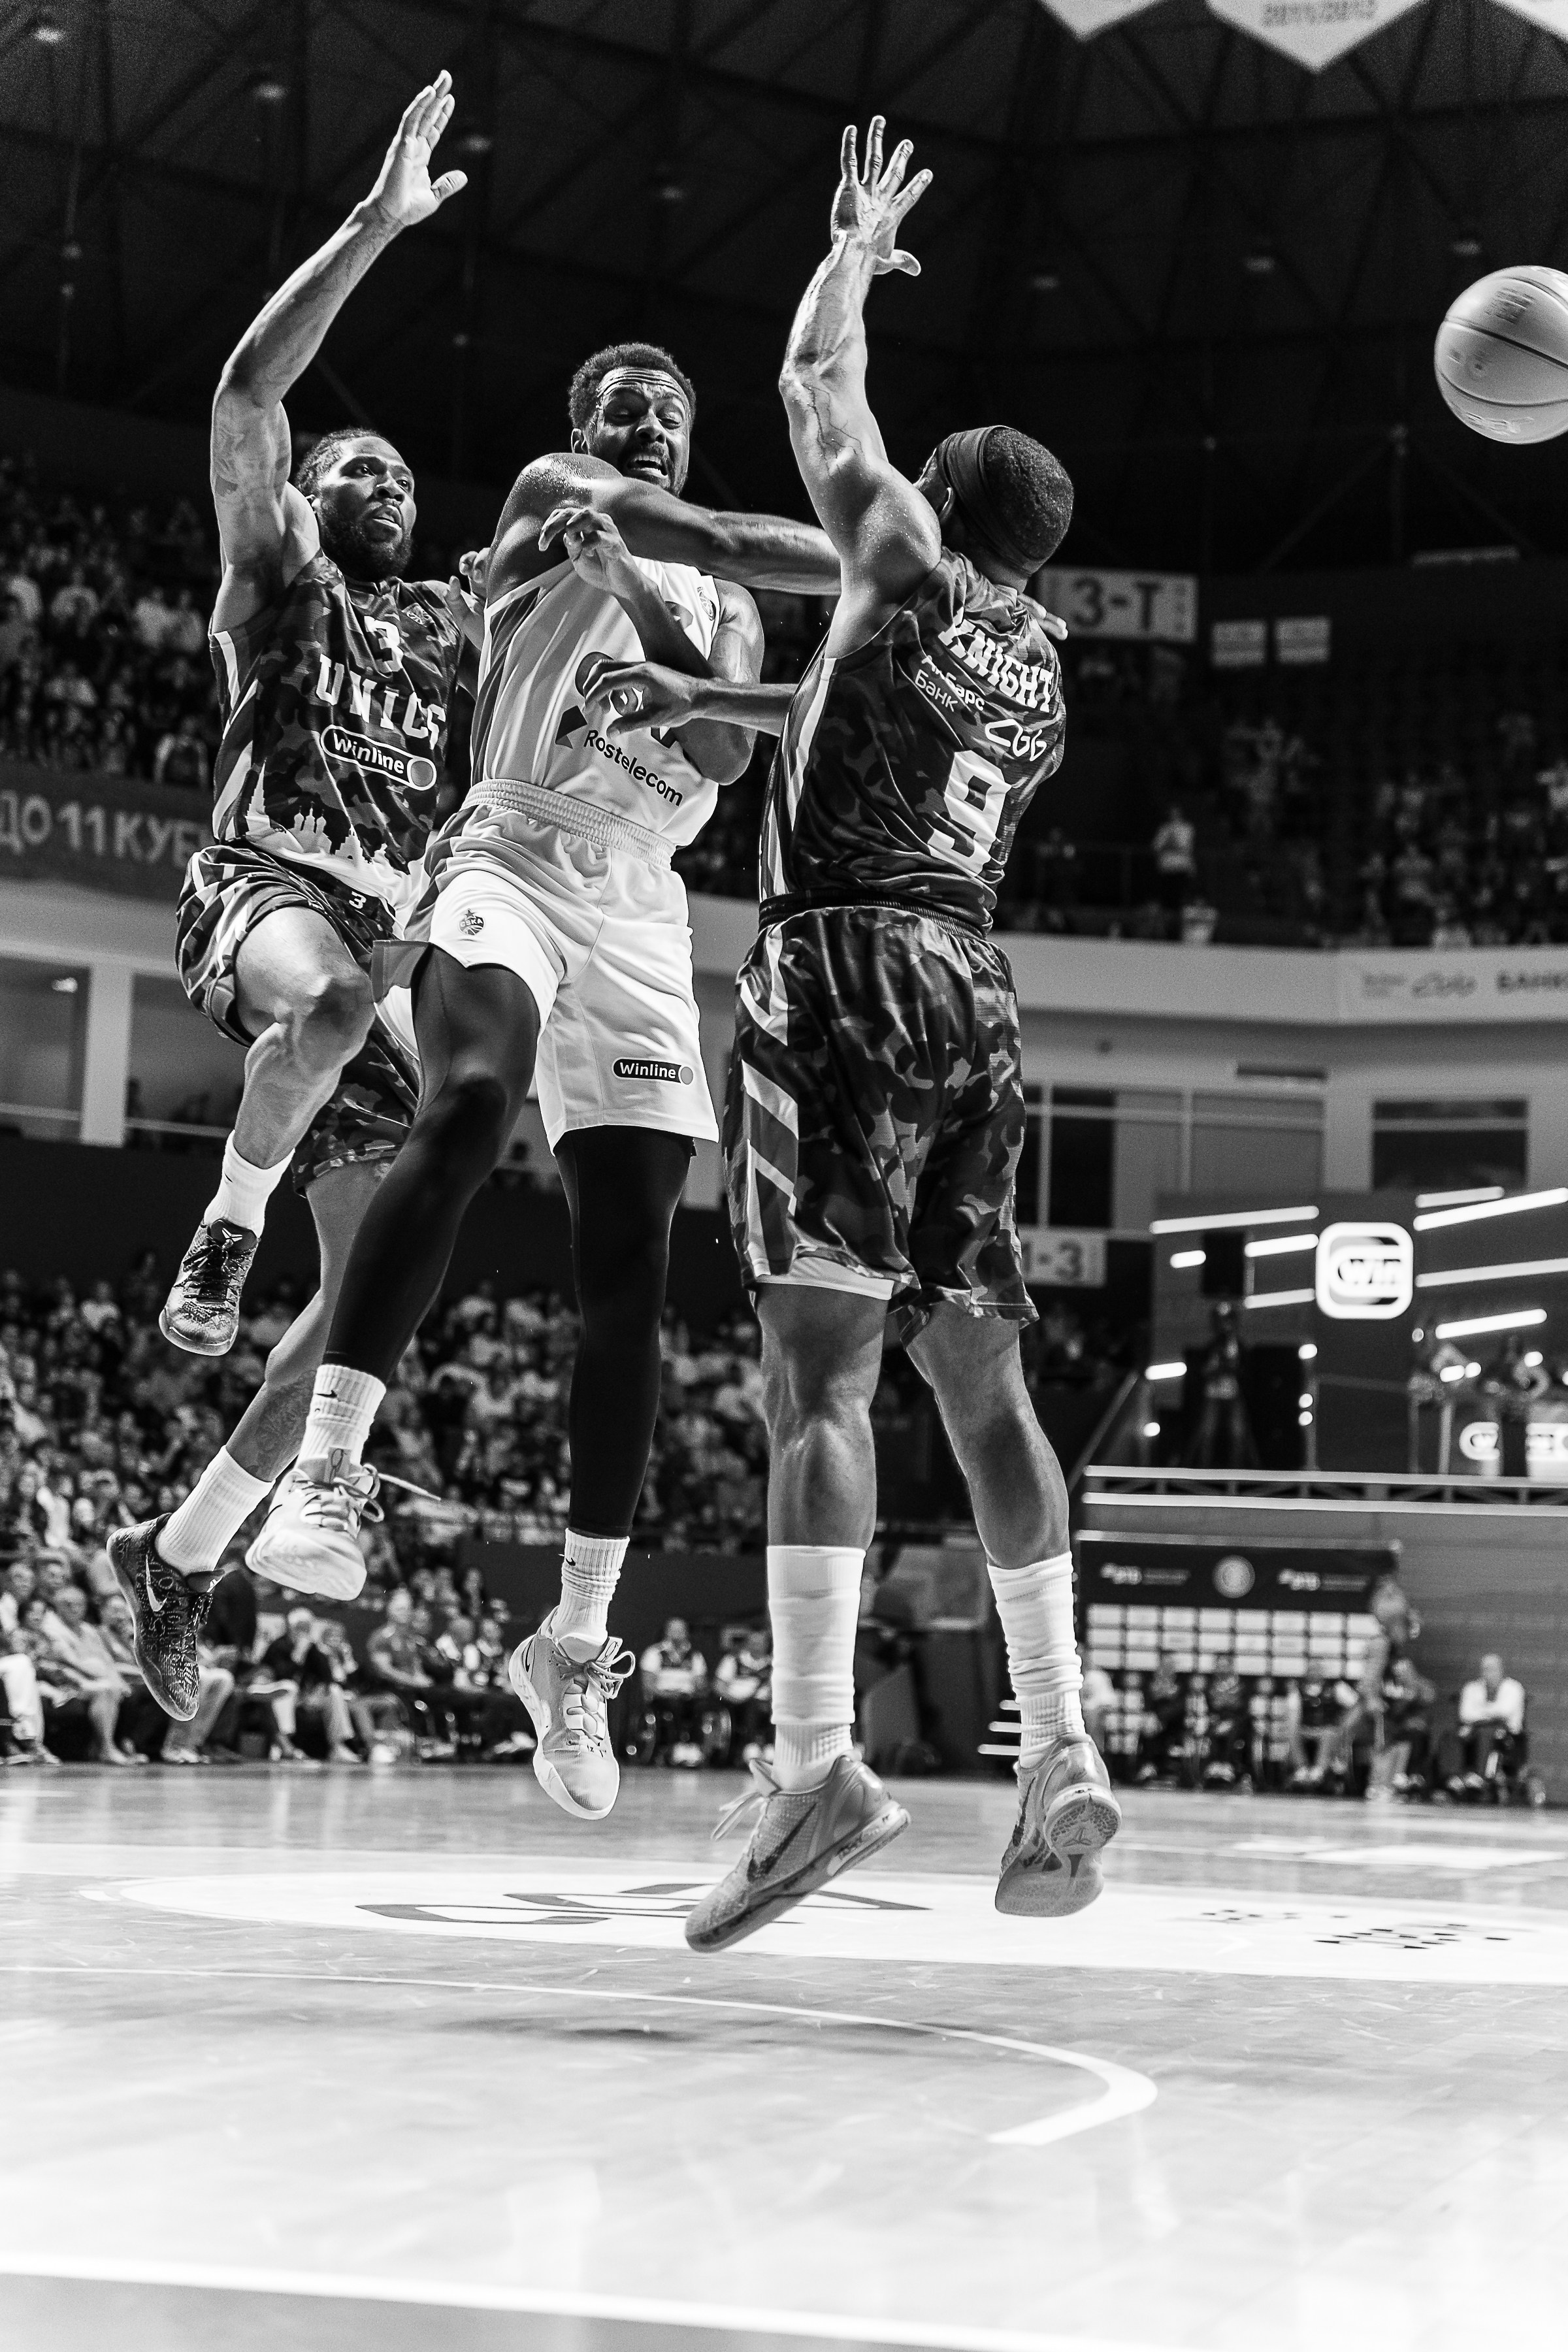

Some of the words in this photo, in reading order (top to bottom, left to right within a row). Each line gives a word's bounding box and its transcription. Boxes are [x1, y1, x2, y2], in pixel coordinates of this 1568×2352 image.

[938, 606, 1054, 713] KNIGHT
[915, 669, 958, 712] Банк
[333, 732, 404, 774] Winline
[583, 730, 683, 806] Rostelecom
[57, 800, 106, 857] 11
[113, 810, 217, 869] КУБ
[928, 750, 1009, 877] 9
[349, 890, 367, 909] 3
[459, 918, 483, 928] CSKA
[619, 1062, 676, 1079] Winline
